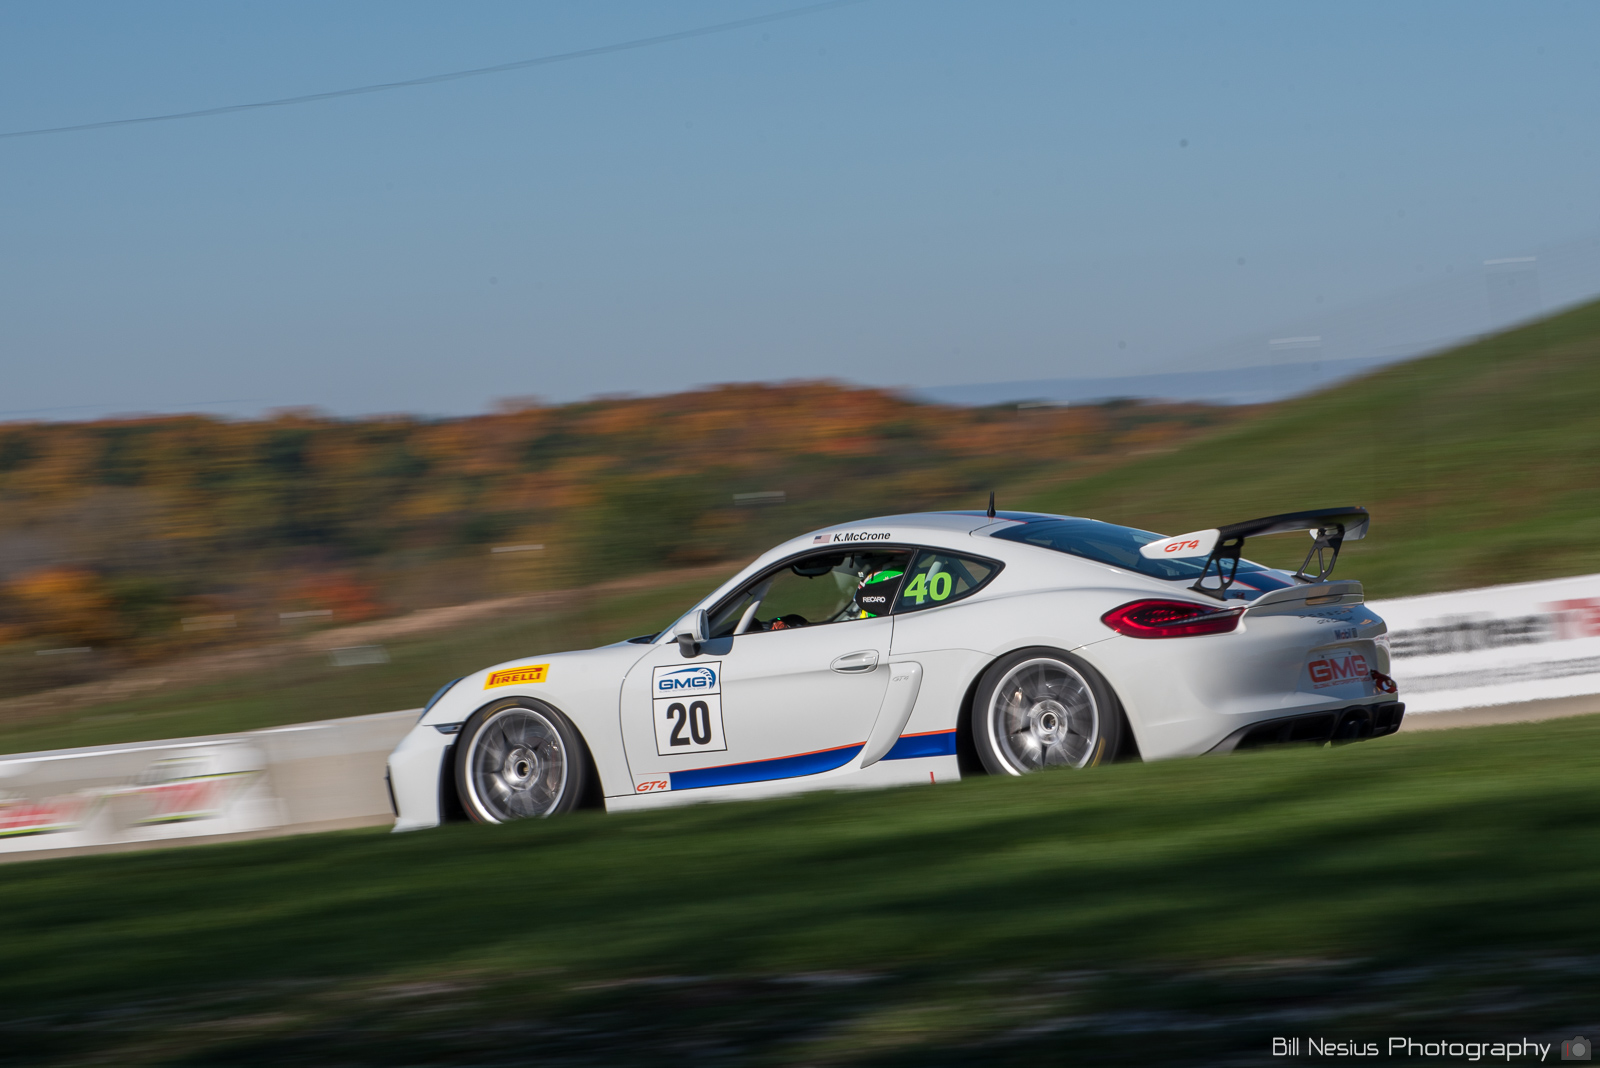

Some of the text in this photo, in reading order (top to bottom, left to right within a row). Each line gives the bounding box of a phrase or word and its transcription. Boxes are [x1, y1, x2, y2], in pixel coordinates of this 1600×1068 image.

[833, 532, 891, 542] K.McCrone
[1164, 540, 1200, 552] GT4
[904, 572, 952, 603] 40
[488, 667, 543, 685] PIRELLI
[1308, 655, 1369, 683] GMG
[659, 677, 707, 690] GMG
[666, 700, 712, 746] 20
[636, 780, 668, 792] GT4
